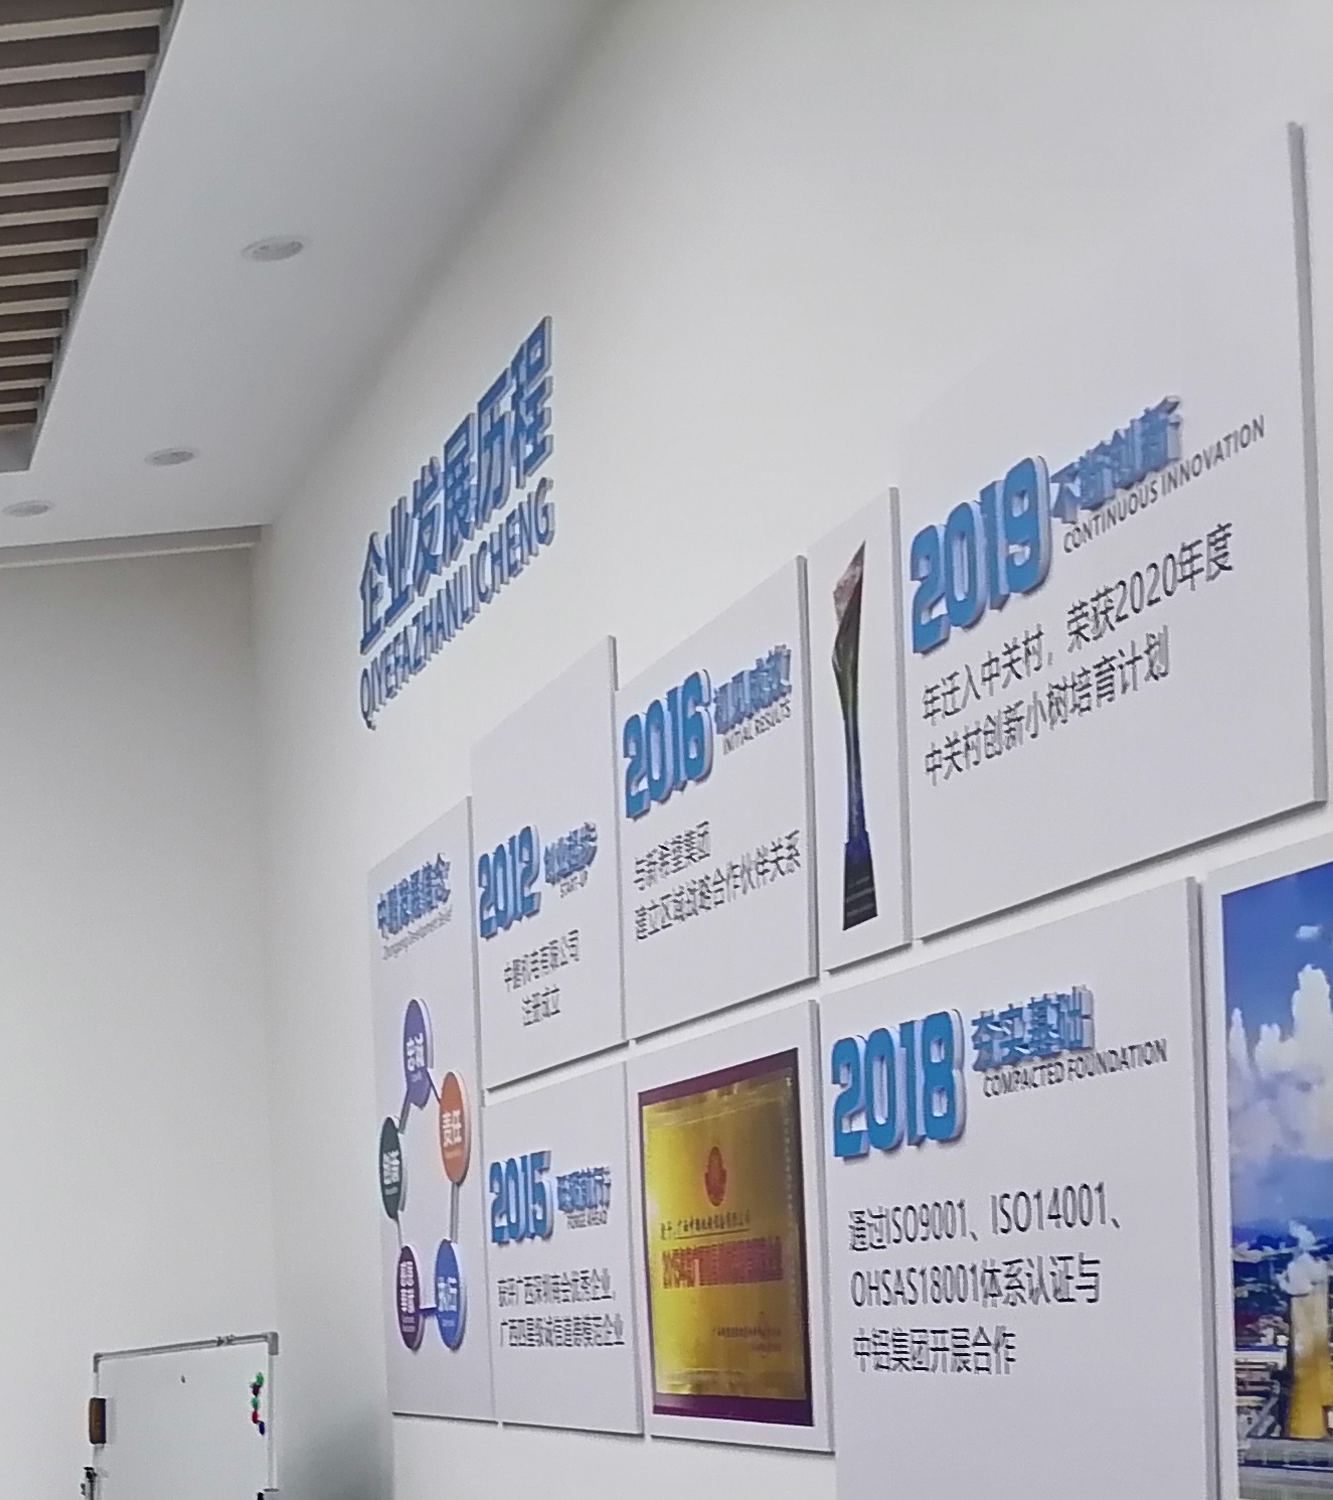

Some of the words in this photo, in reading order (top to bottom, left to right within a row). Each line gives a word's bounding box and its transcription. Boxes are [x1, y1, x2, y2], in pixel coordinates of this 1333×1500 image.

[359, 315, 554, 654] 企业发展历程
[910, 454, 1055, 656] 2019
[1062, 476, 1159, 555] CONTINUOUS
[1160, 413, 1267, 497] INNOVATION
[623, 667, 714, 821] 2016
[923, 625, 1172, 787] 中关村创新小树培育计划
[478, 824, 542, 940] 2012
[831, 1008, 965, 1160] 2018
[982, 1060, 1065, 1099] COMPACTED
[1066, 1037, 1169, 1082] FOUNDATION
[489, 1150, 555, 1246] 2015
[850, 1252, 1102, 1309] OHSAS18001体系认证与
